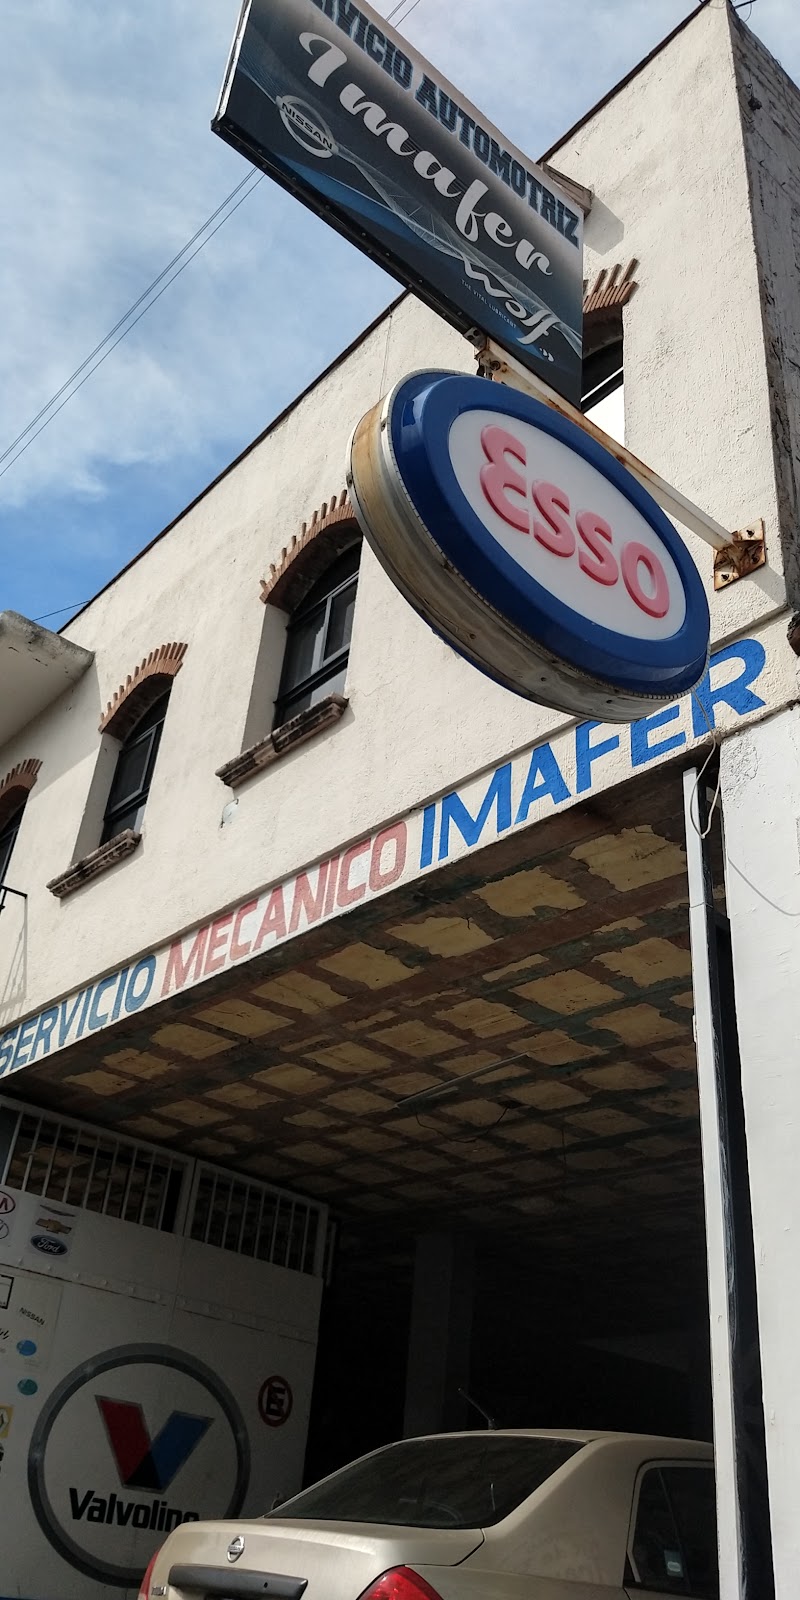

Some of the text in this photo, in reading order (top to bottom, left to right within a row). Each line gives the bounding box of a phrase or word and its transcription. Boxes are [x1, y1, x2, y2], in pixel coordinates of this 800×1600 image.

[280, 103, 334, 151] NISSAN
[299, 32, 553, 276] Imafer
[414, 76, 579, 247] AUTOMOTRIZ
[461, 279, 517, 329] THE VITAL LUBRICANT
[0, 638, 766, 1077] SERVICIO MECANICO IMAFER
[37, 1237, 61, 1253] Ford
[19, 1307, 46, 1326] NISSAN
